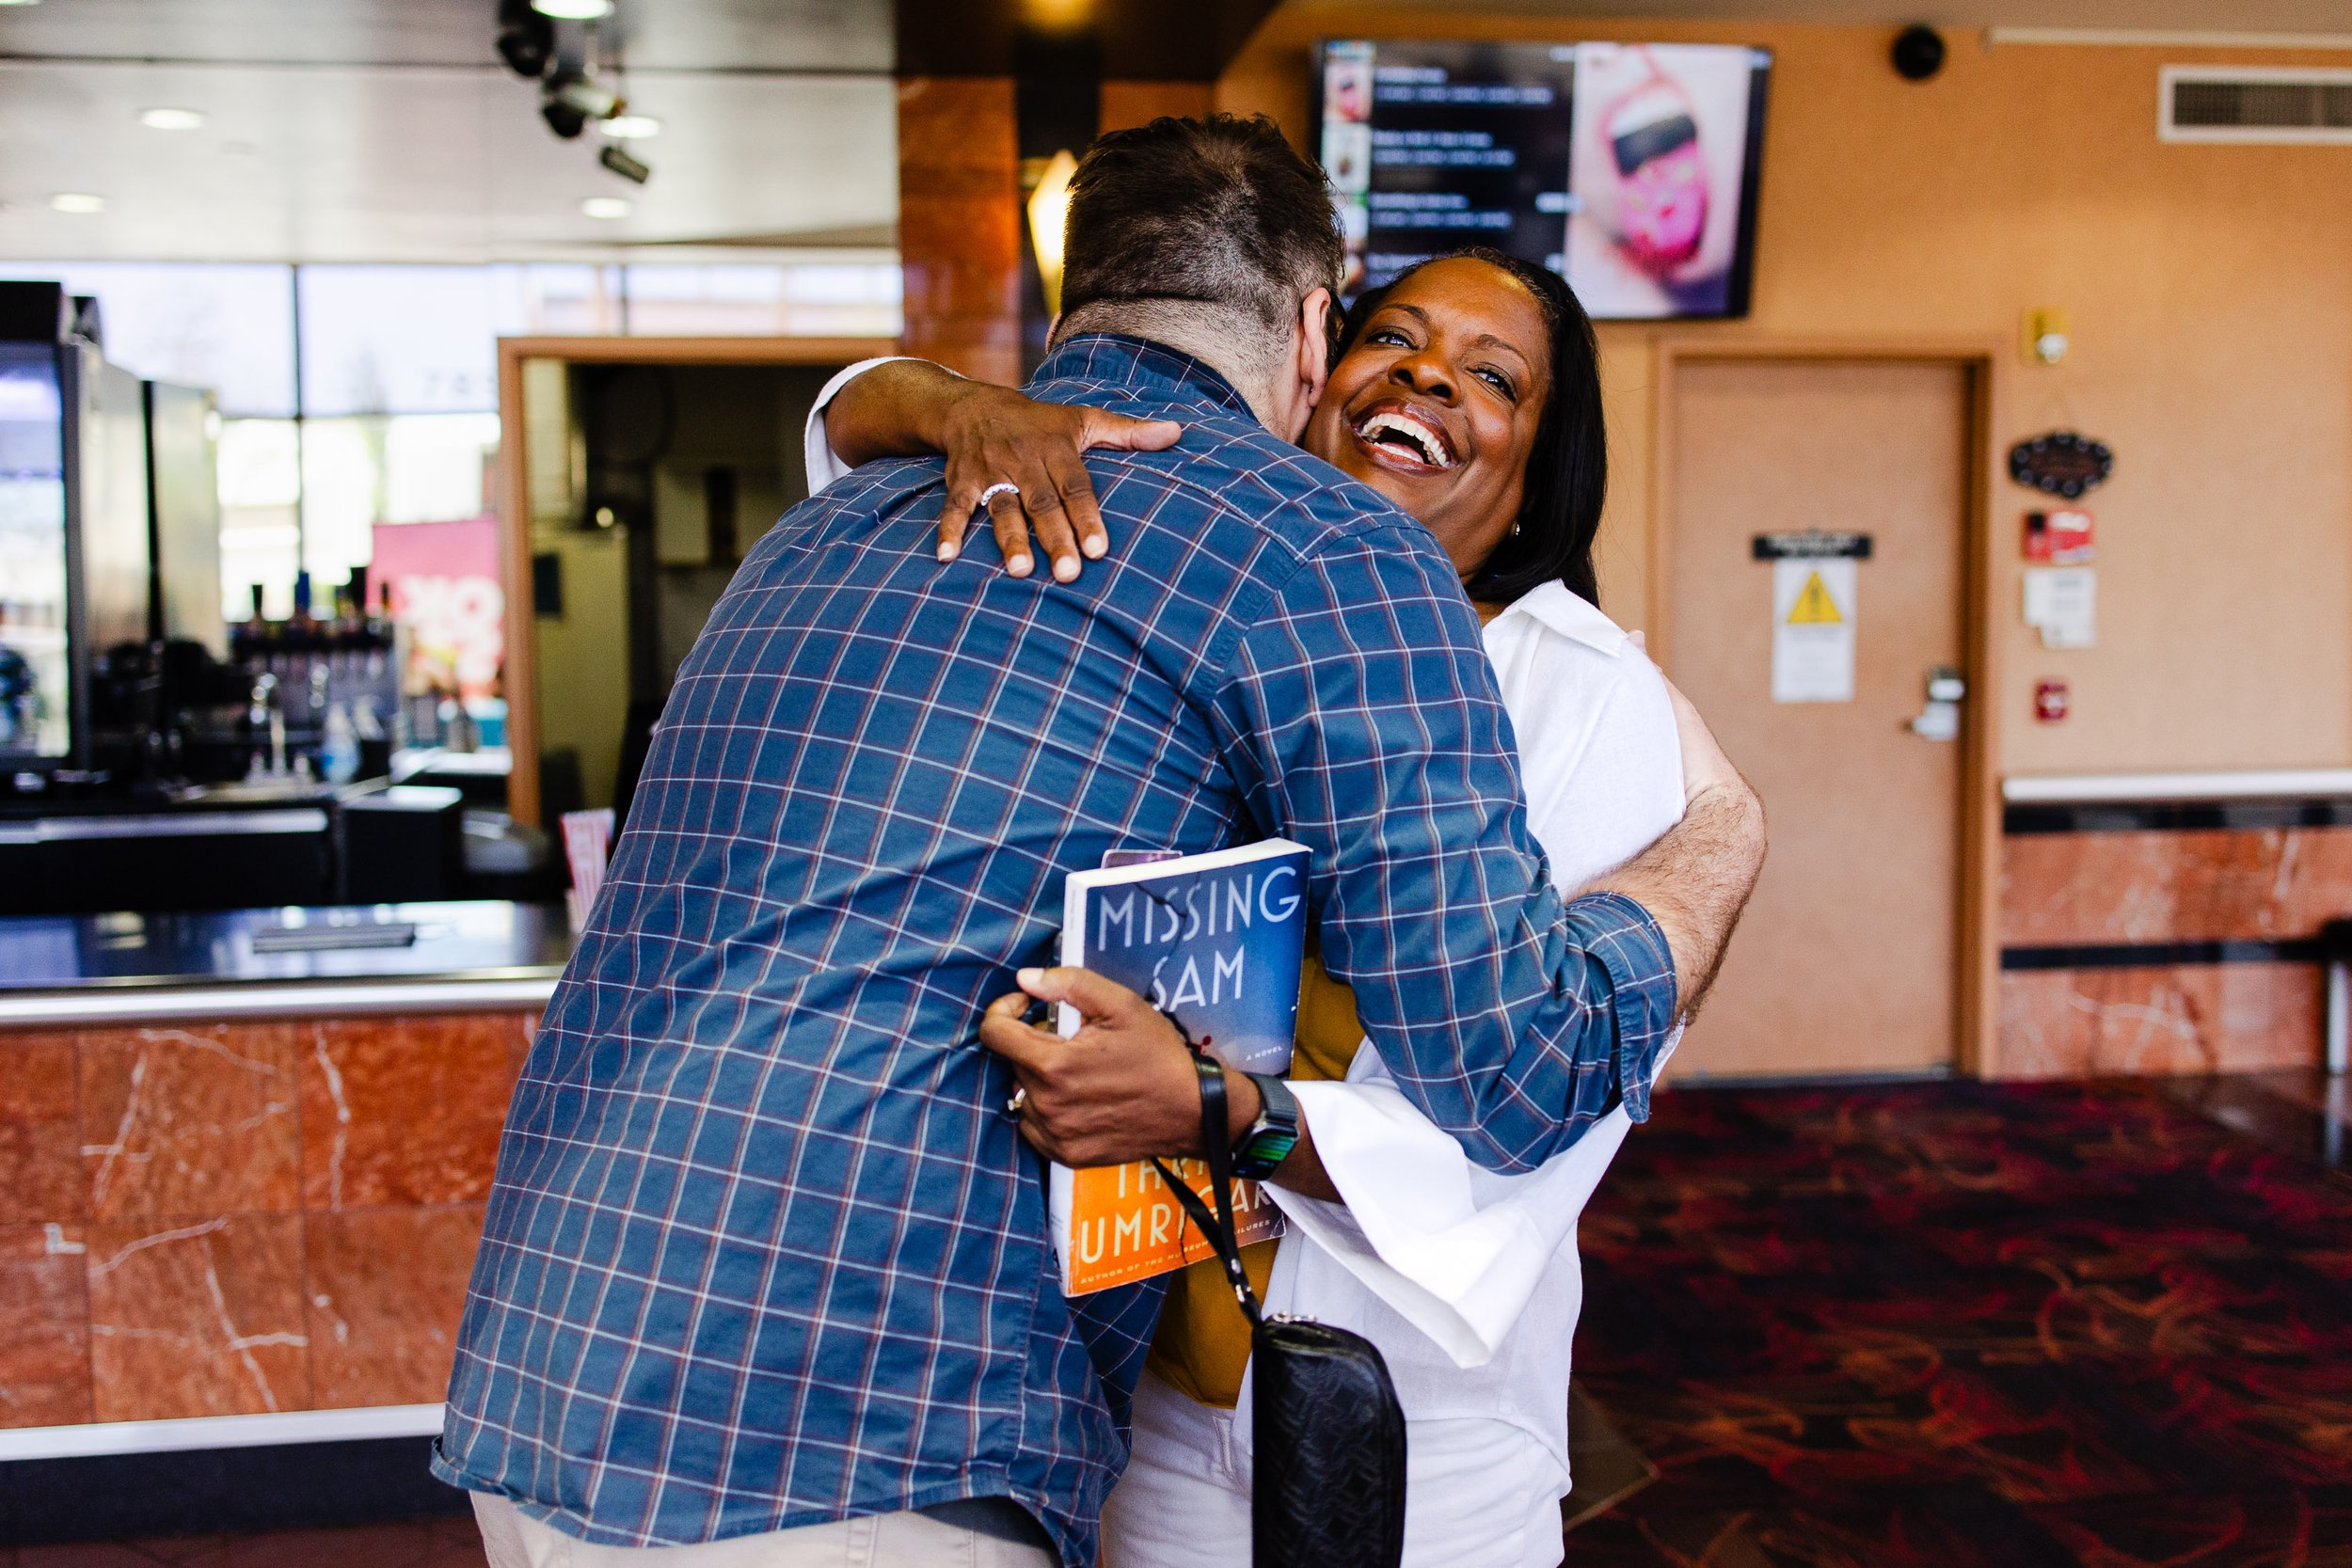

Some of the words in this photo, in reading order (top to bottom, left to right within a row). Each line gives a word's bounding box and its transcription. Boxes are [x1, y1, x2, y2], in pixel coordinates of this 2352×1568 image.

[1098, 865, 1301, 952] MISSING
[1151, 944, 1245, 1013] SAM
[1246, 1053, 1252, 1062] A
[1254, 1045, 1283, 1059] NOVEL
[1080, 1268, 1123, 1284] AUTHOR
[1127, 1263, 1140, 1273] OF
[1144, 1257, 1164, 1267] THE
